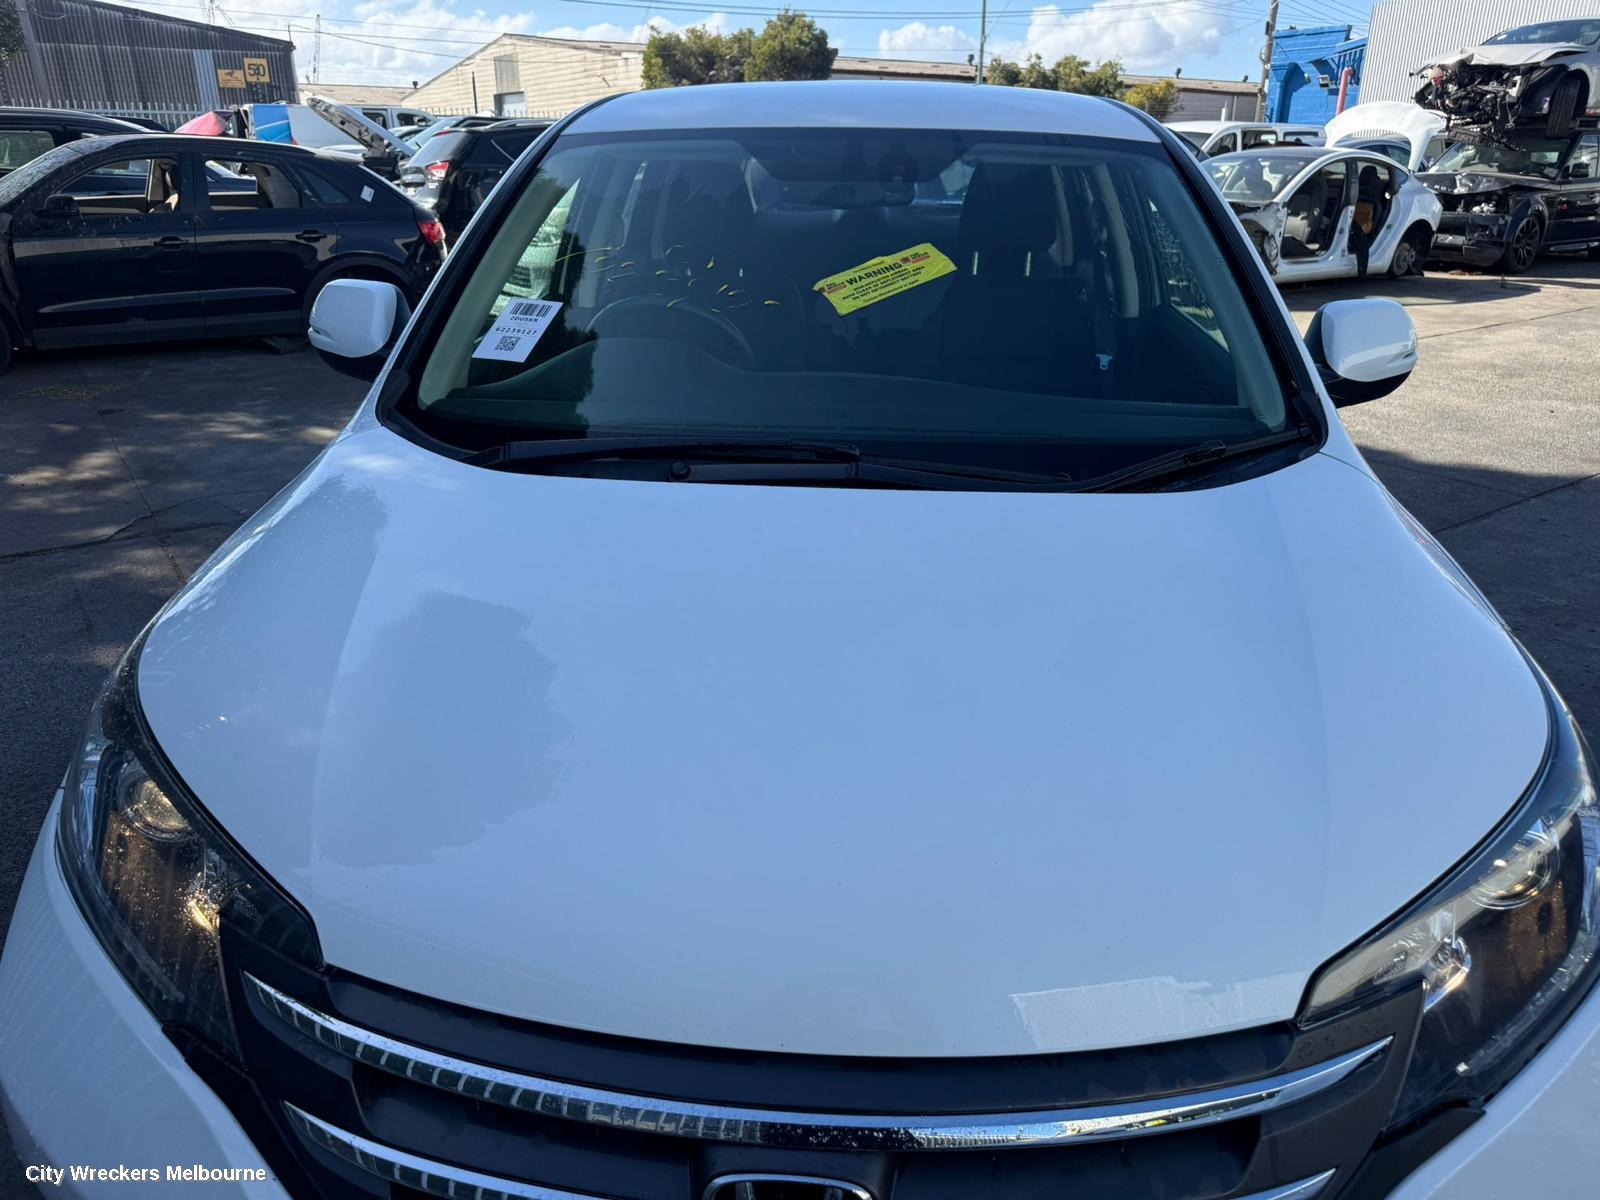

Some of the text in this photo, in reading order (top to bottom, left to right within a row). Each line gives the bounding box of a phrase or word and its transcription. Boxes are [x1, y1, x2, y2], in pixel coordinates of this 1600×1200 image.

[247, 63, 266, 77] 50
[845, 262, 902, 286] WARNING
[495, 327, 537, 335] 62239127
